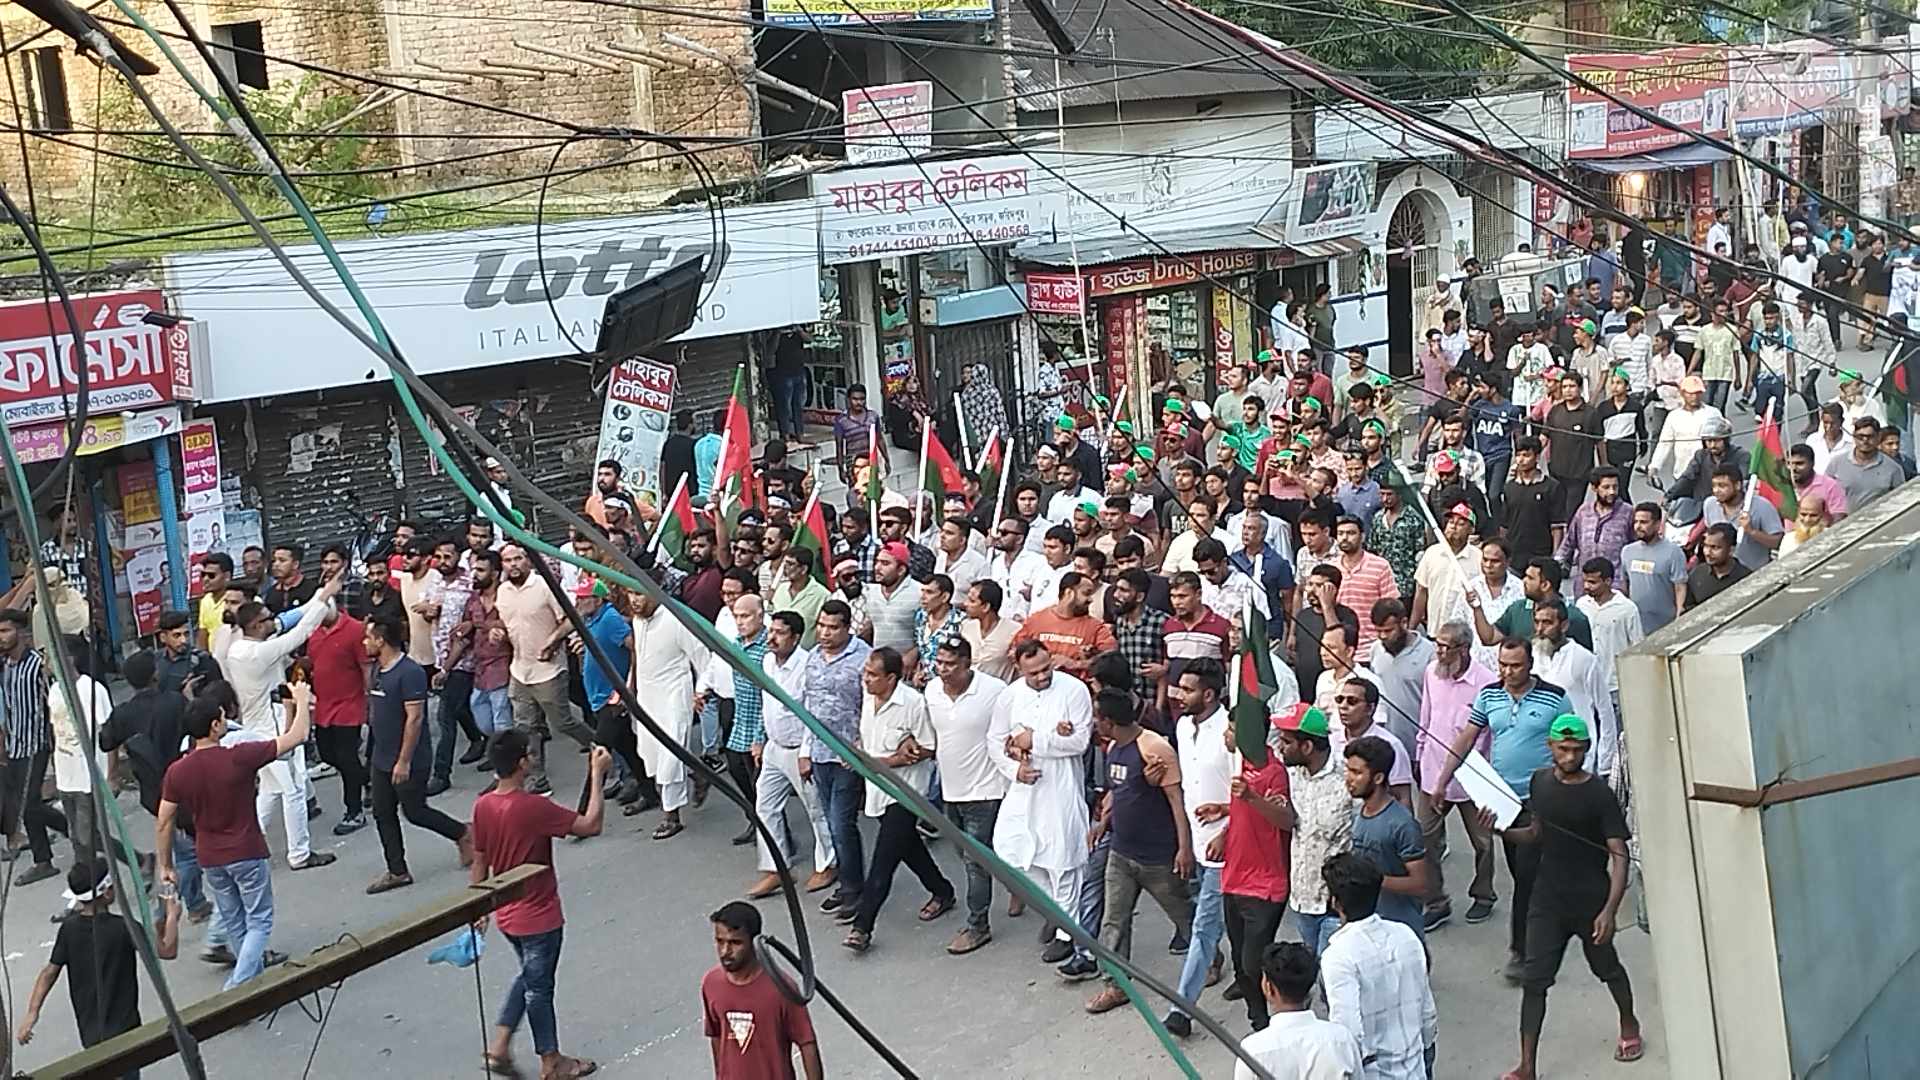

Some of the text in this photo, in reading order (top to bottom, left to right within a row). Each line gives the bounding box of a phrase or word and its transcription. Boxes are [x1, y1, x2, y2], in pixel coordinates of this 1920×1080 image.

[828, 179, 926, 216] মাহাবুব
[933, 163, 1029, 205] টেলিকম
[1153, 260, 1197, 282] Drug
[1202, 252, 1255, 274] House
[1476, 419, 1504, 437] AIA
